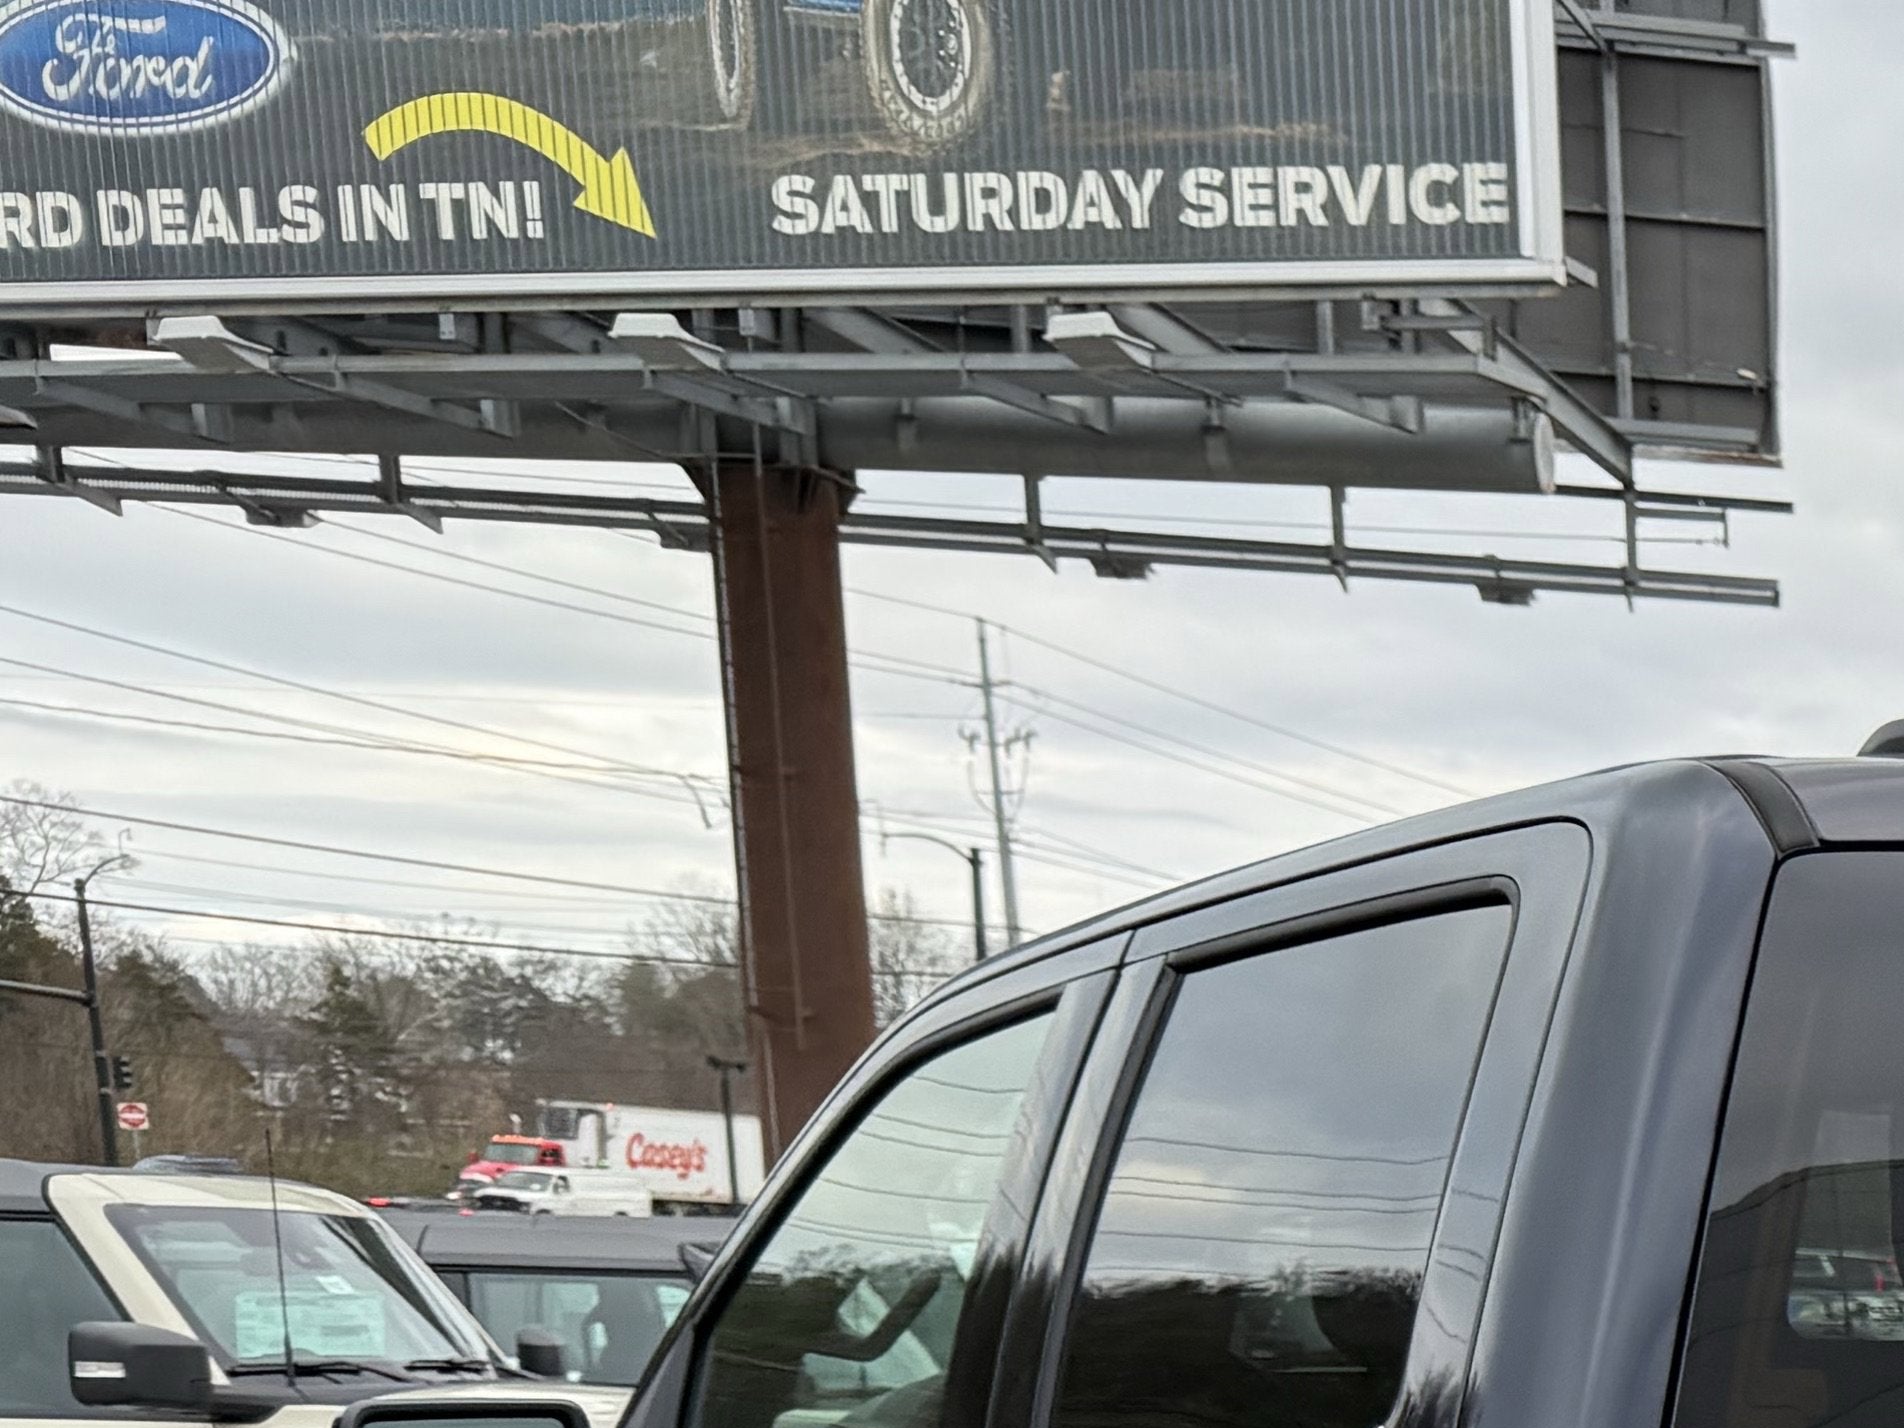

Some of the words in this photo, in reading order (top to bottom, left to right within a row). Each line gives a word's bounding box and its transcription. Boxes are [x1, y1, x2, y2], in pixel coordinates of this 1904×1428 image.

[41, 12, 214, 103] Ford
[97, 185, 325, 247] DEALS
[337, 183, 410, 243] IN
[419, 180, 544, 242] TN!
[770, 167, 1164, 236] SATURDAY
[1178, 162, 1510, 230] SERVICE
[625, 1131, 708, 1180] Casey's
